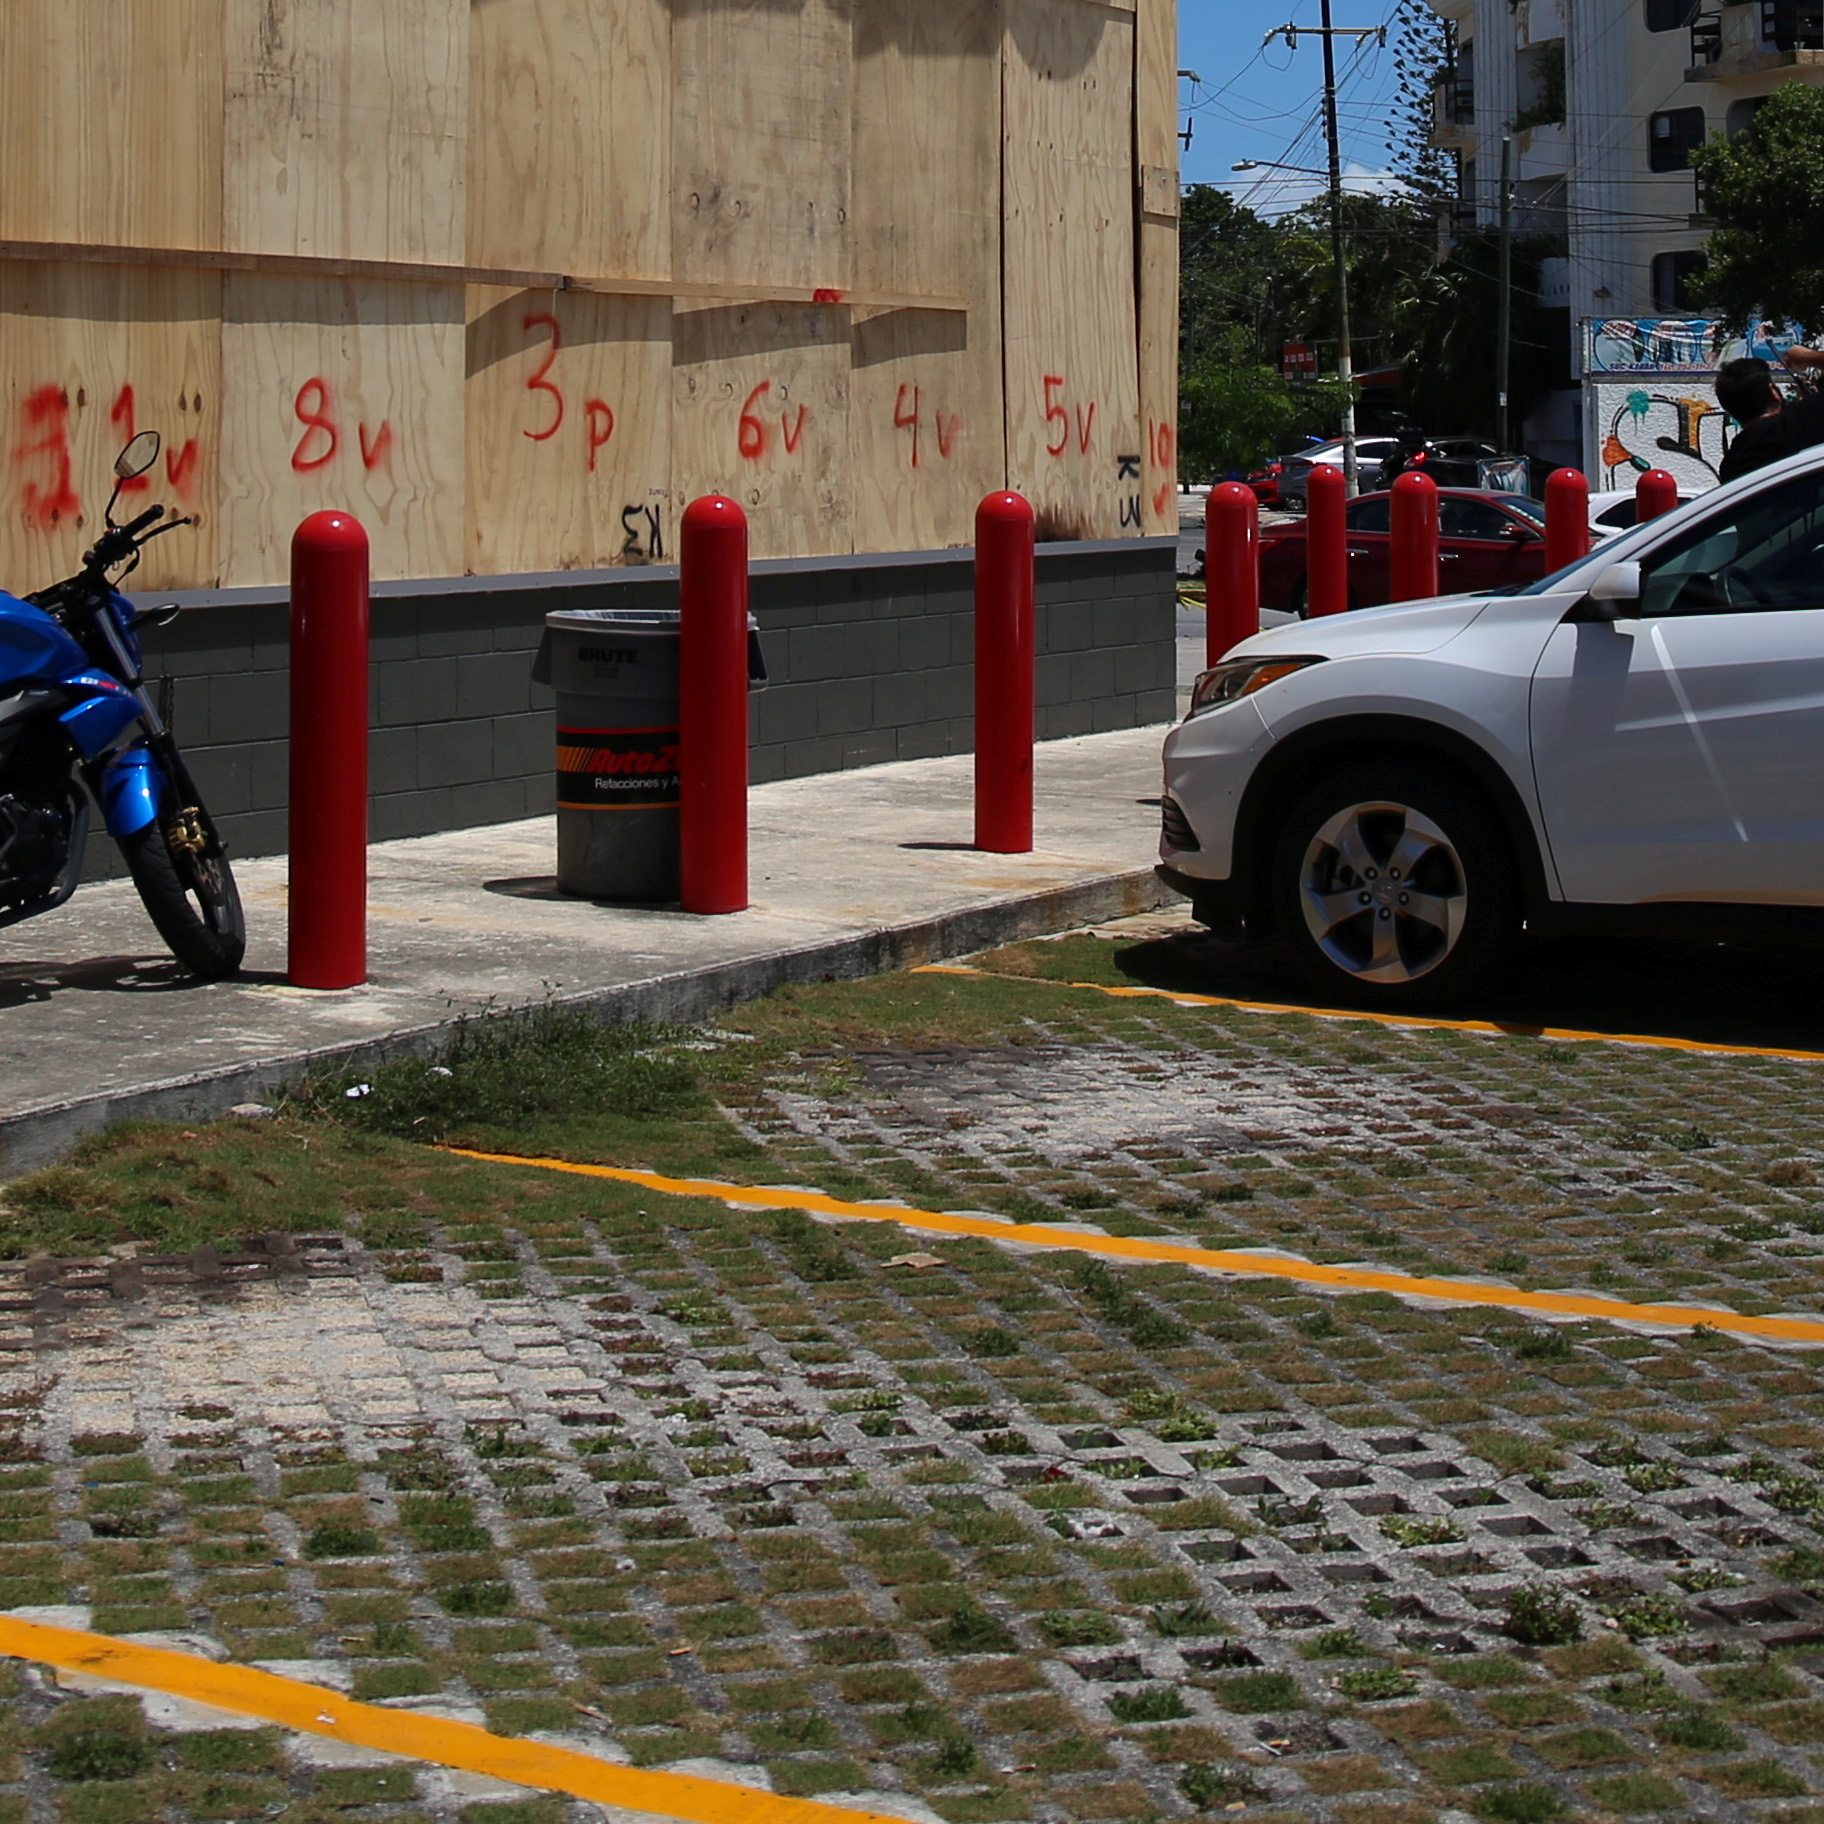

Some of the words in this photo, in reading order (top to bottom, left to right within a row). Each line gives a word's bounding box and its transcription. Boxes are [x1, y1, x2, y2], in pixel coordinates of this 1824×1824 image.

[578, 646, 640, 664] BRUTE
[586, 745, 680, 774] AutoZ
[594, 777, 659, 790] Refacciones
[660, 778, 669, 791] y
